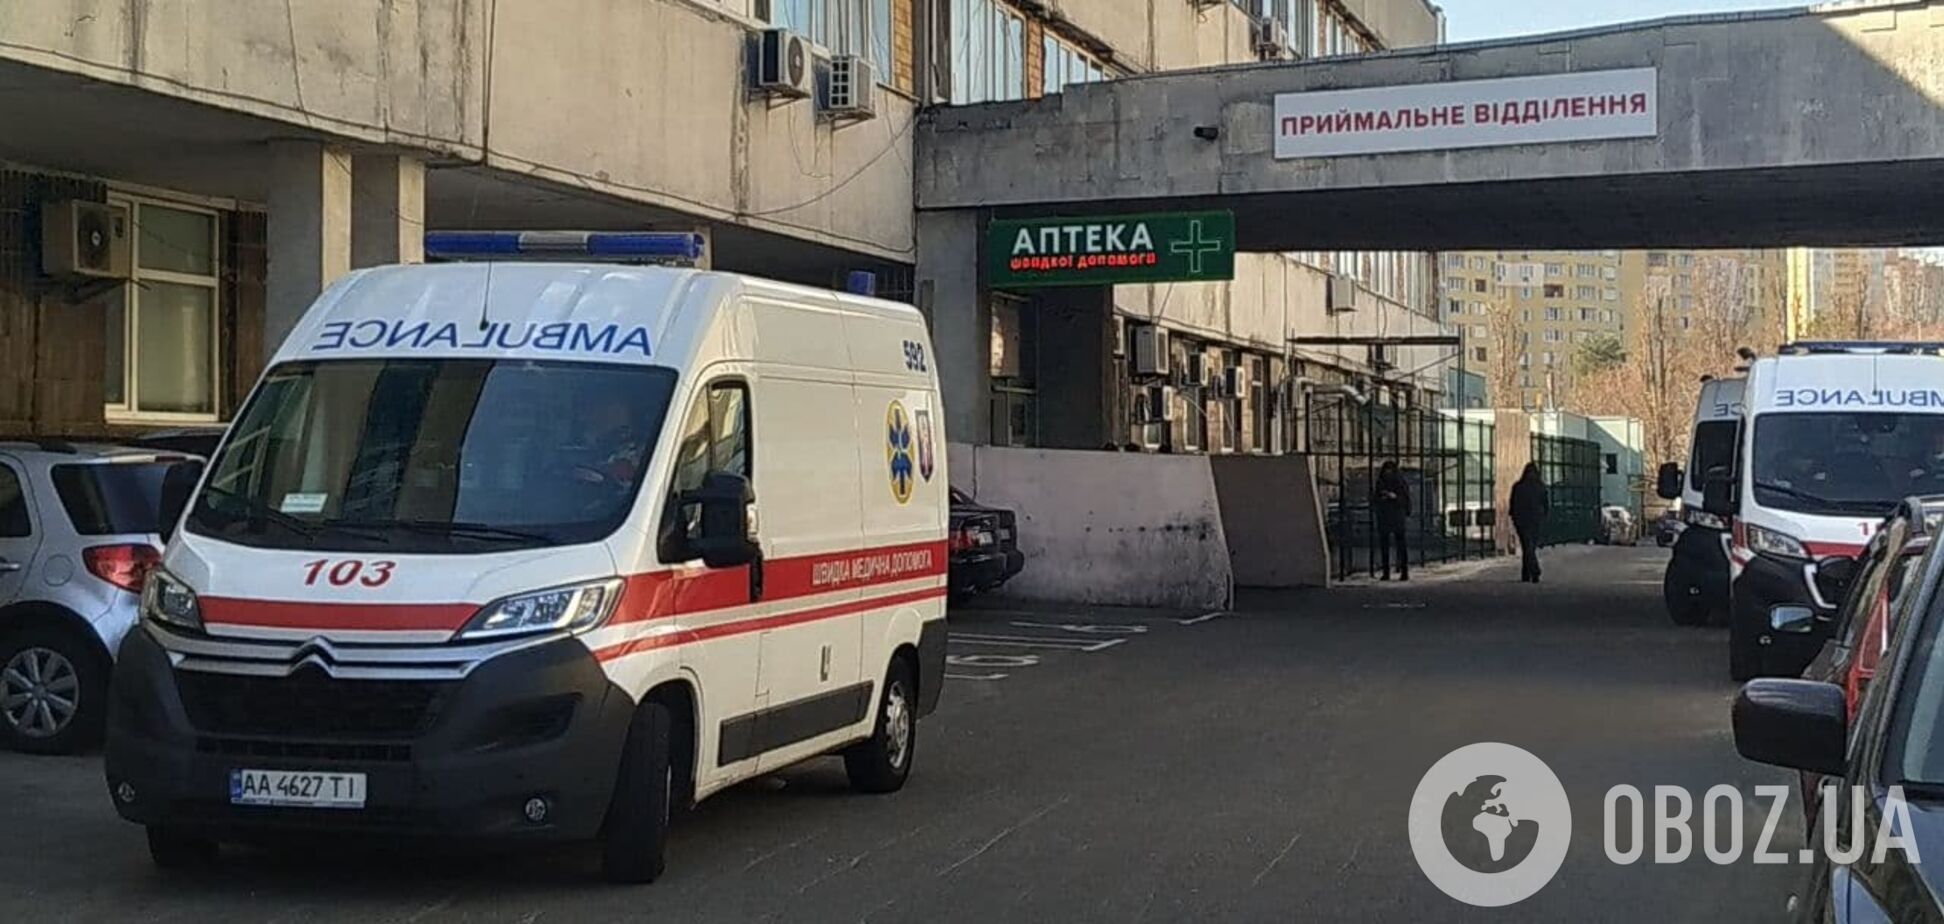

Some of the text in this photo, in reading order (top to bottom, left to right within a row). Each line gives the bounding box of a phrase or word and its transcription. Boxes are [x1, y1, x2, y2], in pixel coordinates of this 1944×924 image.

[1280, 92, 1647, 137] ПРИЙМАЛЬНЕ ВІДДІЛЕННЯ
[1012, 223, 1154, 255] АПТЕКА
[902, 340, 927, 372] 592
[304, 558, 397, 588] 103
[813, 550, 932, 586] ШВИДКА МЕДИЧНА ДОПОМОГА
[243, 773, 271, 796] AA
[277, 774, 324, 798] 4627
[329, 776, 354, 798] TI
